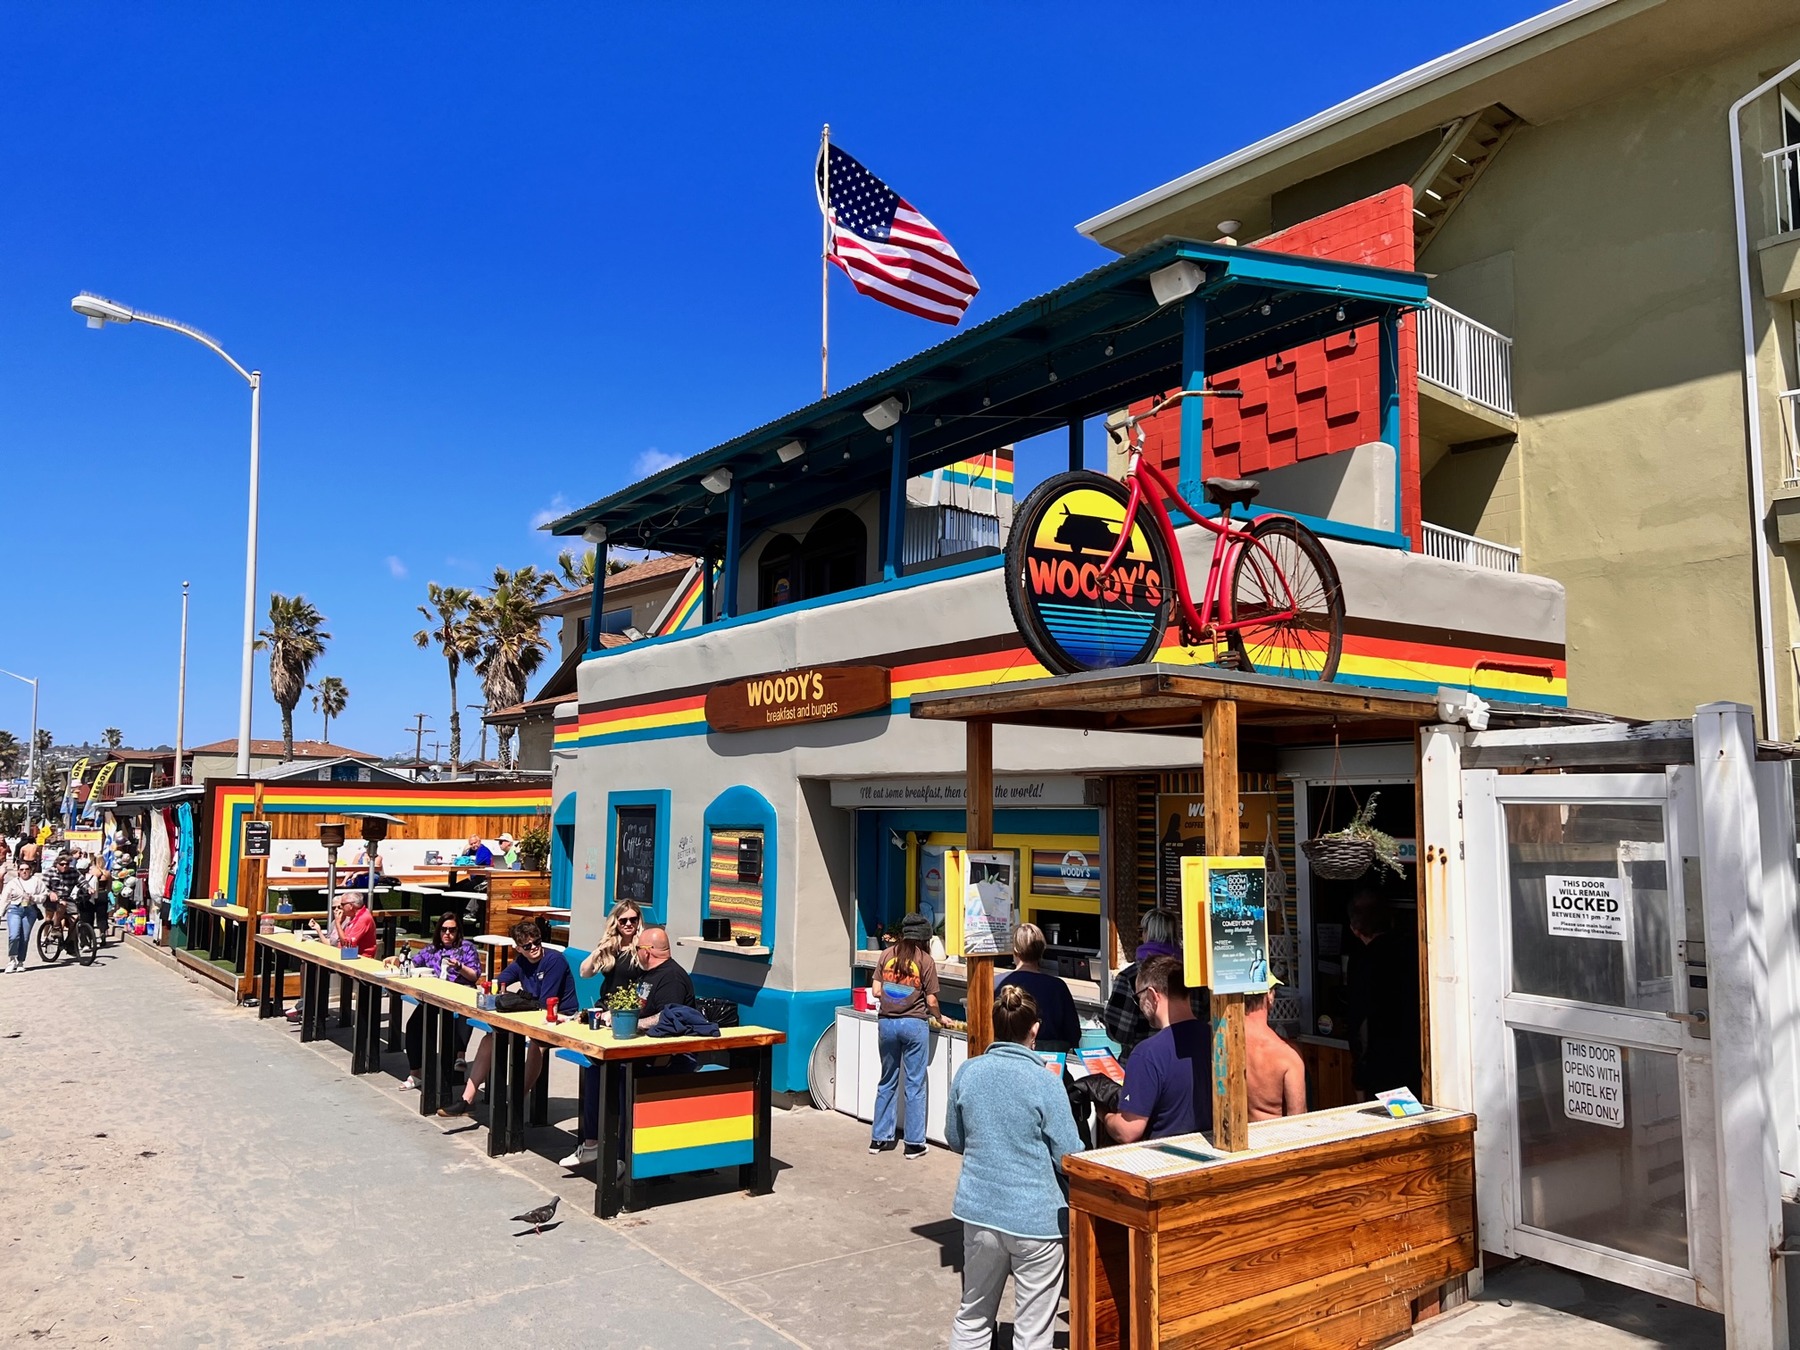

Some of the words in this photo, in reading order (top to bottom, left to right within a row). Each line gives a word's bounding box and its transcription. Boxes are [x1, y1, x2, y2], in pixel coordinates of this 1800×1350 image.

[1028, 556, 1162, 607] WOODY'S
[747, 670, 824, 706] WOODY'S
[766, 706, 796, 722] breakfast
[796, 703, 810, 718] and
[810, 702, 838, 718] burgers
[92, 766, 112, 798] LESSONS
[860, 786, 872, 799] I'll
[873, 787, 884, 799] eat
[885, 788, 902, 799] some
[904, 785, 942, 802] breakfast,
[944, 785, 961, 798] then
[994, 785, 1008, 798] the
[1010, 782, 1044, 798] world!
[1060, 866, 1090, 878] WOODY'S
[1552, 896, 1618, 912] LOCKED
[1566, 1042, 1586, 1058] THIS
[1589, 1046, 1616, 1062] DOOR
[1565, 1061, 1594, 1078] OPENS
[1597, 1066, 1620, 1083] WITH
[1568, 1080, 1597, 1098] HOTEL
[1600, 1086, 1618, 1102] KEY
[1569, 1099, 1593, 1116] CARD
[1596, 1104, 1619, 1121] ONLY
